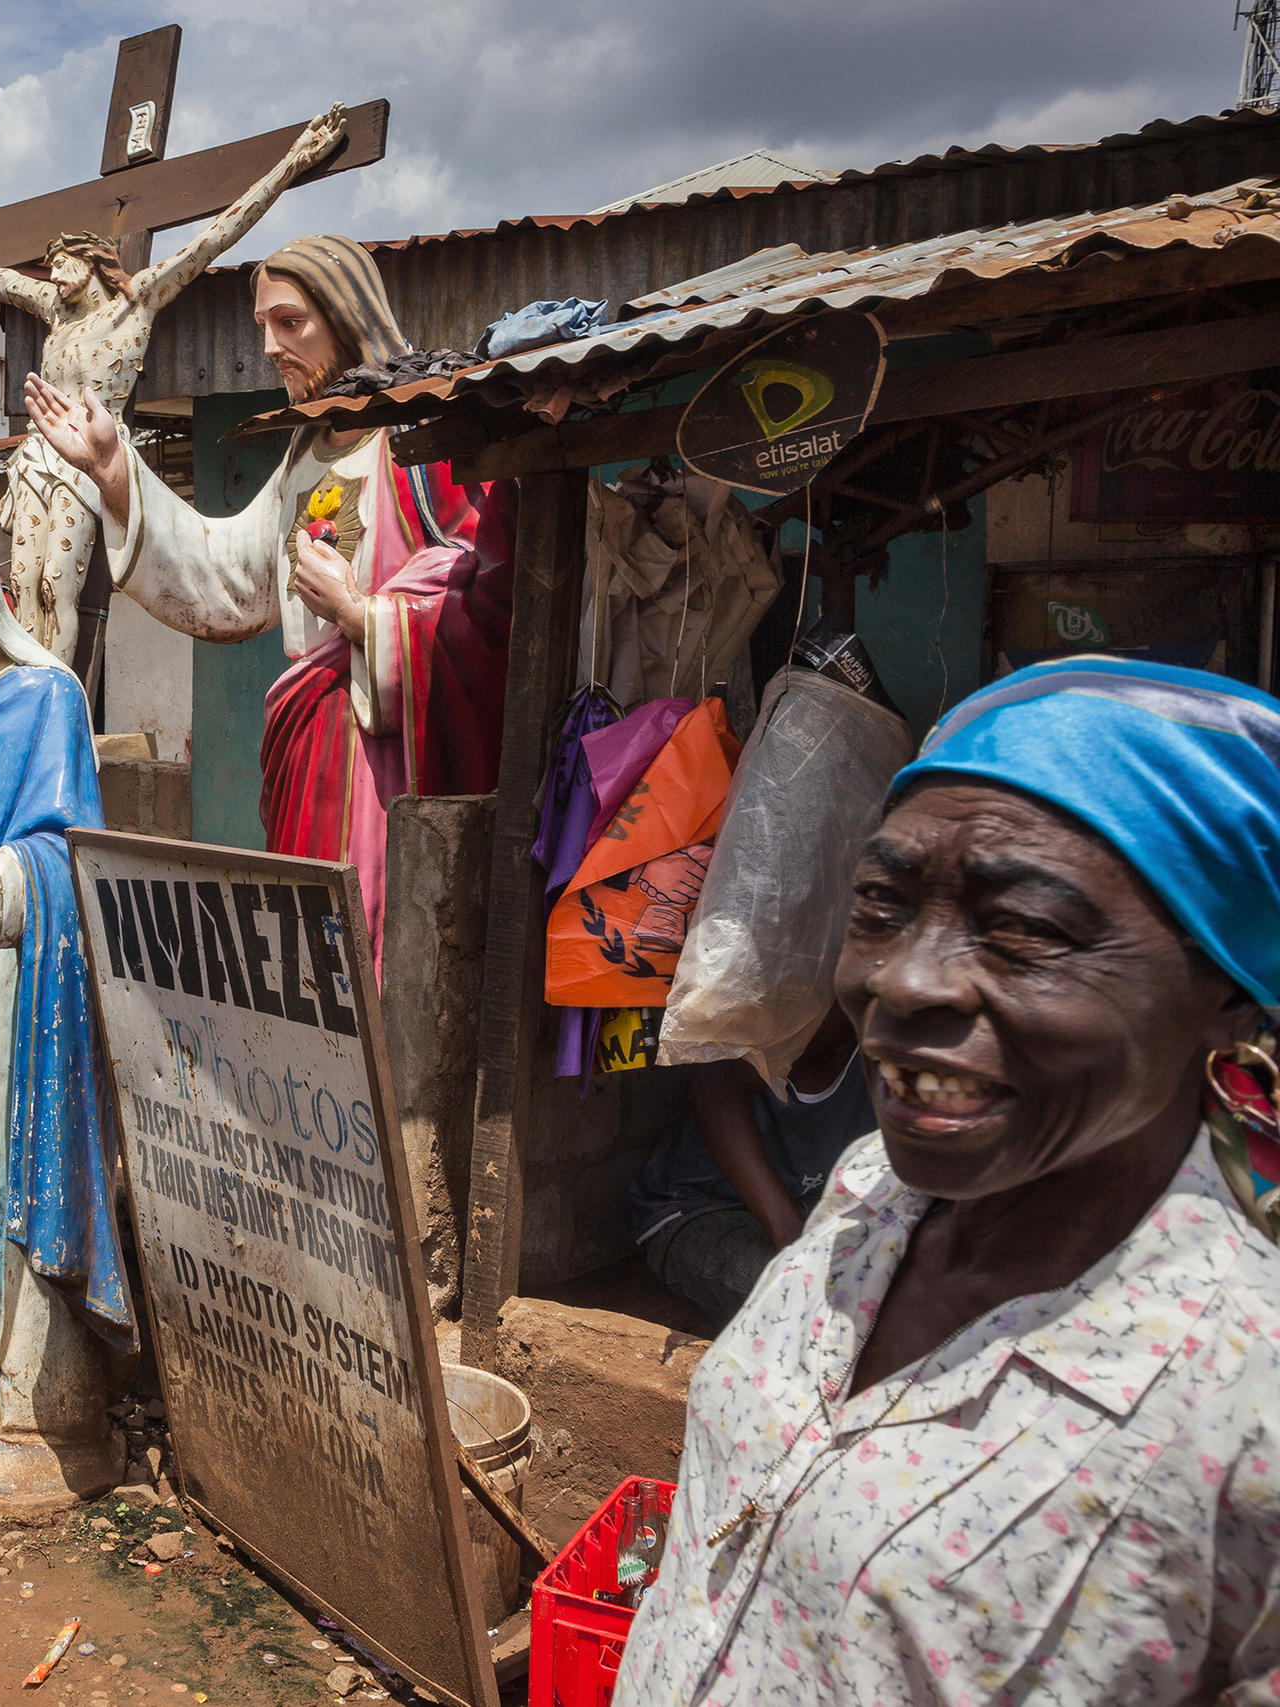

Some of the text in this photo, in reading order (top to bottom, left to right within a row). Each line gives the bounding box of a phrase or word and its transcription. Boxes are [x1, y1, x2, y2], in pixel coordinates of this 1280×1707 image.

[755, 430, 844, 468] etisalat
[95, 879, 359, 1039] NWAEZE
[131, 1093, 210, 1157] DIGITAL
[210, 1120, 306, 1192] INSTANT
[166, 1015, 380, 1166] Photos
[136, 1139, 151, 1190] 2
[289, 1197, 402, 1302] PASSPORT
[170, 1243, 413, 1412] ID PHOTO SYSTEM
[174, 1331, 268, 1419] PRINTS
[183, 1293, 343, 1422] LAMINATION
